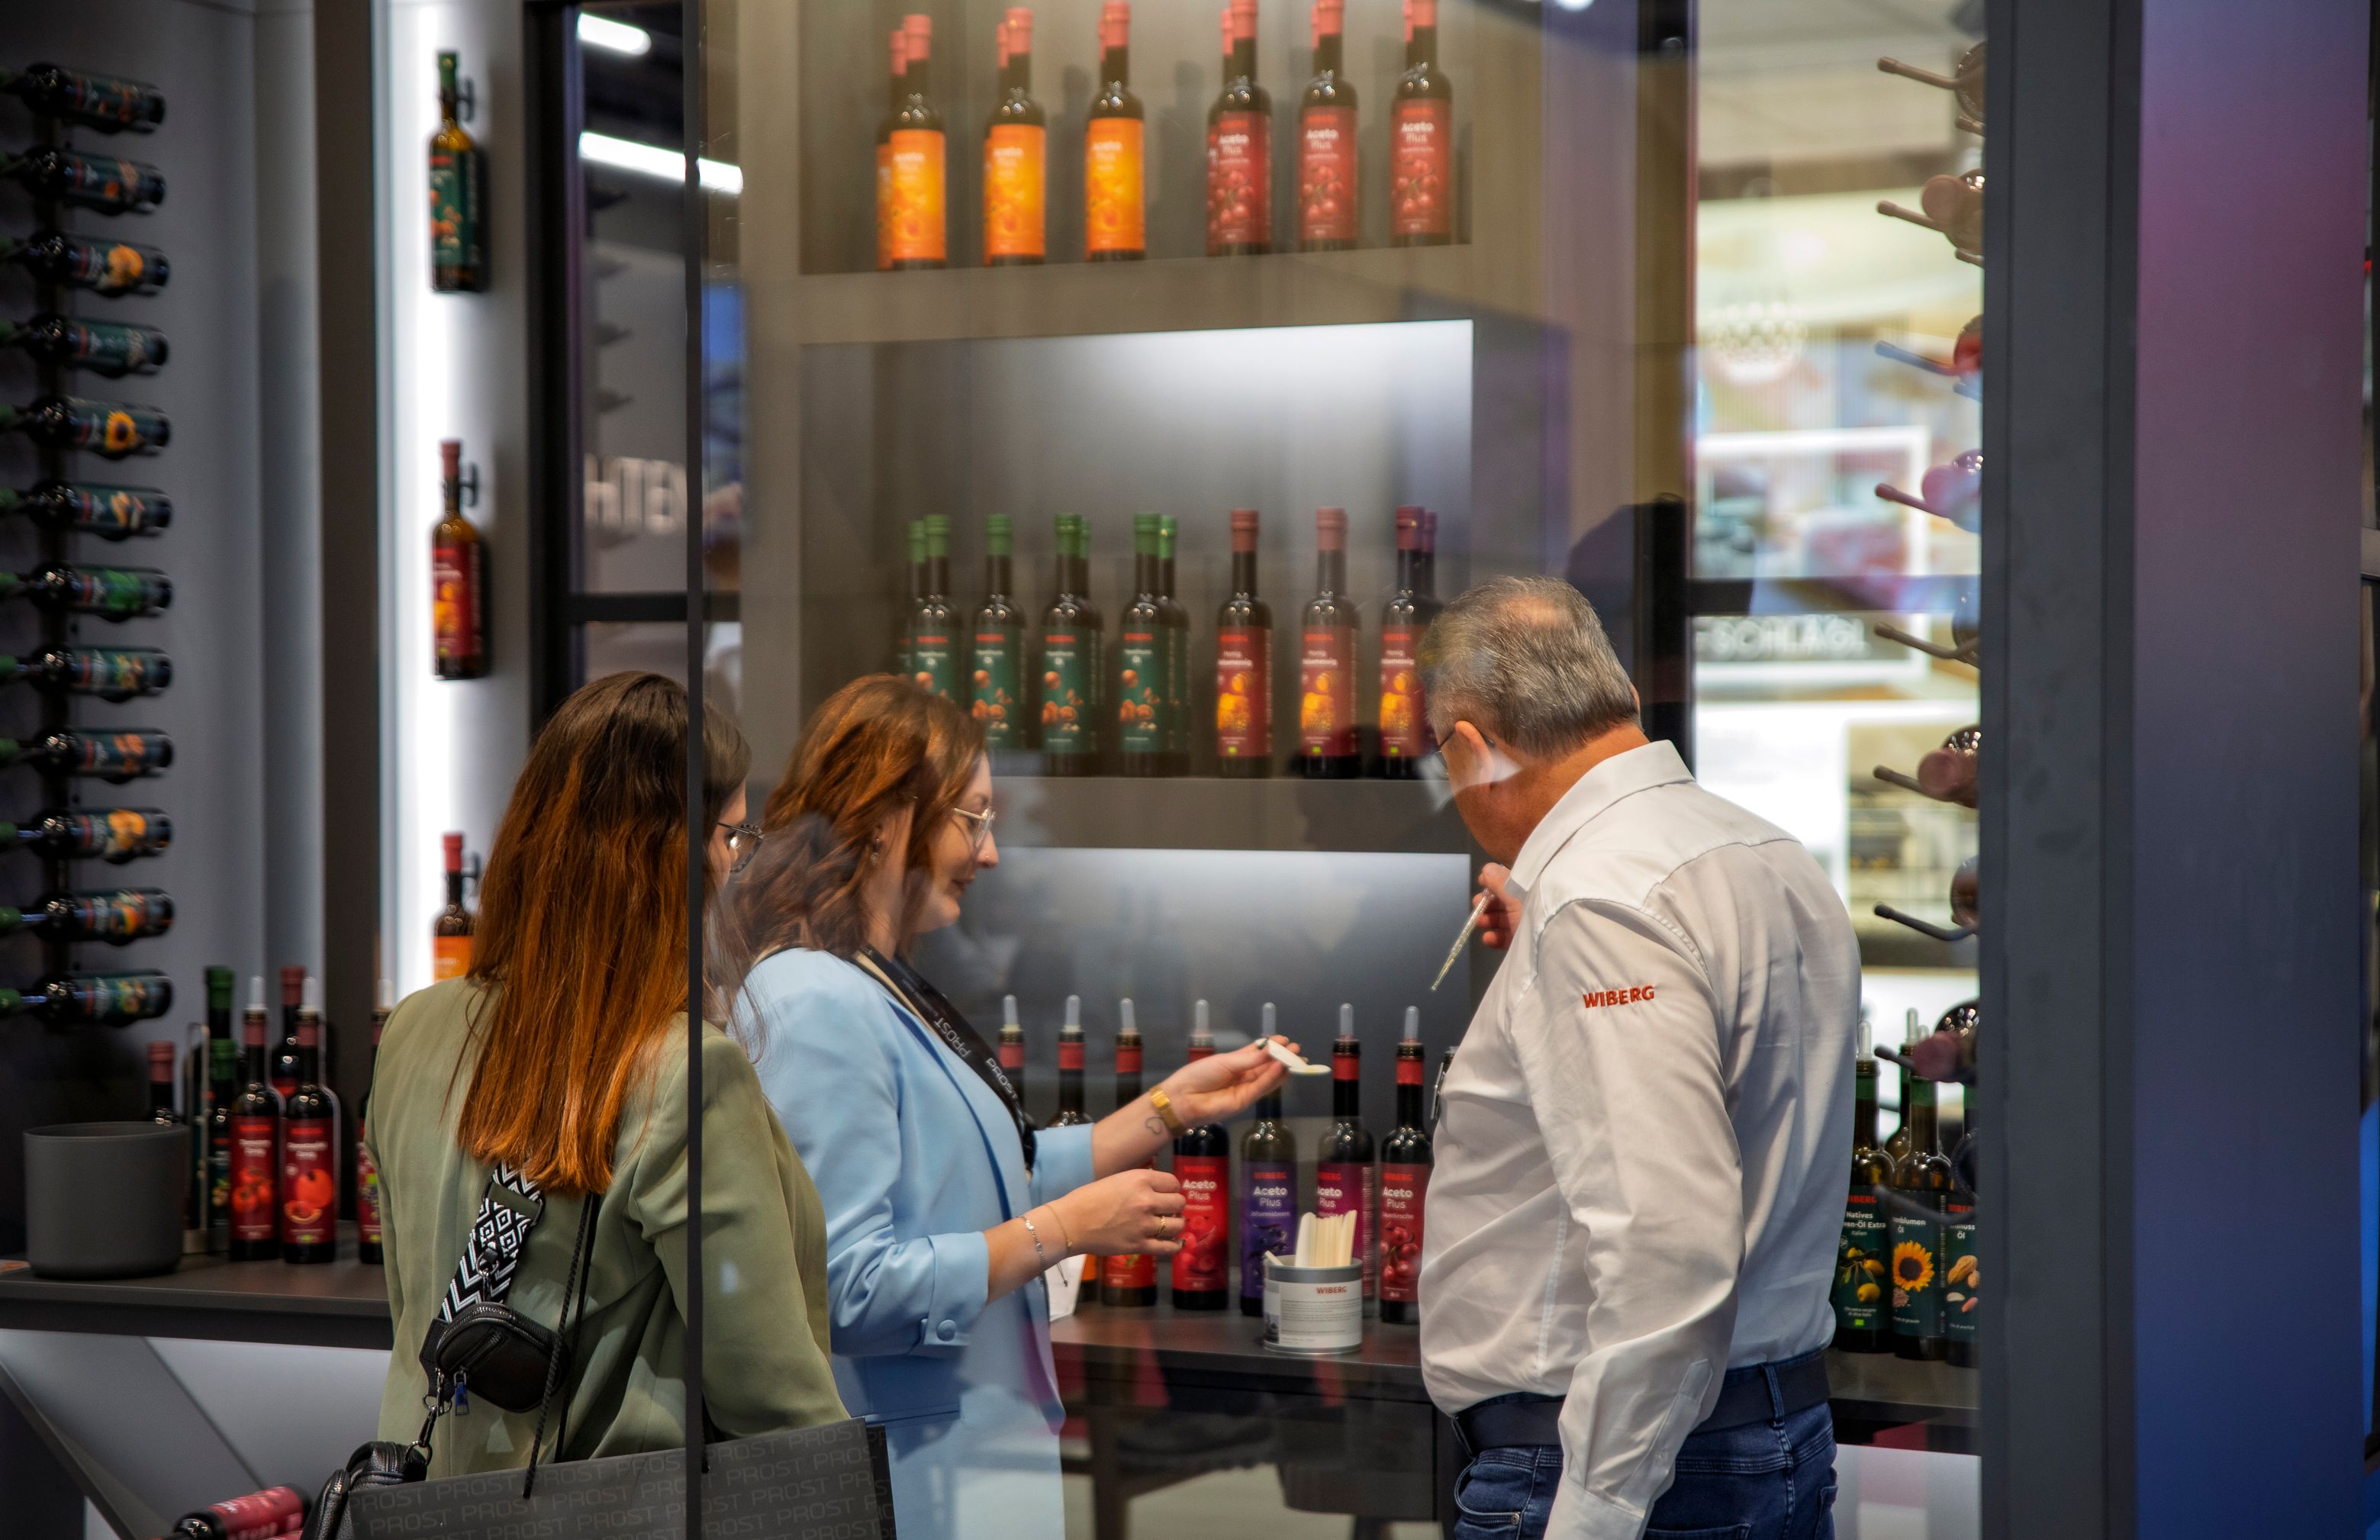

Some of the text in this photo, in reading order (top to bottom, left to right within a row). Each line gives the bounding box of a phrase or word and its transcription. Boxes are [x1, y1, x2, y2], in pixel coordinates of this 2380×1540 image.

[1583, 984, 1655, 1008] WIBERG
[933, 1017, 971, 1058] PROST
[1183, 1179, 1217, 1190] Aceto
[1189, 1190, 1210, 1201] Plus
[1253, 1186, 1288, 1197] Aceto
[1317, 1187, 1343, 1198] Aceto
[1383, 1187, 1414, 1198] Aceto
[1260, 1197, 1282, 1207] Plus
[1319, 1197, 1337, 1208] Plus
[1386, 1198, 1406, 1209] Plus
[1846, 1211, 1873, 1219] Natives
[1956, 1231, 1966, 1239] Öl
[1316, 1286, 1348, 1294] WIBERG
[436, 1473, 517, 1501] PROST
[787, 1424, 865, 1450] PROST
[369, 1508, 451, 1536] PROST
[460, 1496, 543, 1522] PROST
[551, 1484, 633, 1510] PROST
[726, 1458, 805, 1487] PROST
[486, 1517, 567, 1540] PROST
[576, 1506, 656, 1532] PROST
[751, 1477, 830, 1506] PROST
[704, 1513, 768, 1539] ROST
[776, 1497, 855, 1526] PROST
